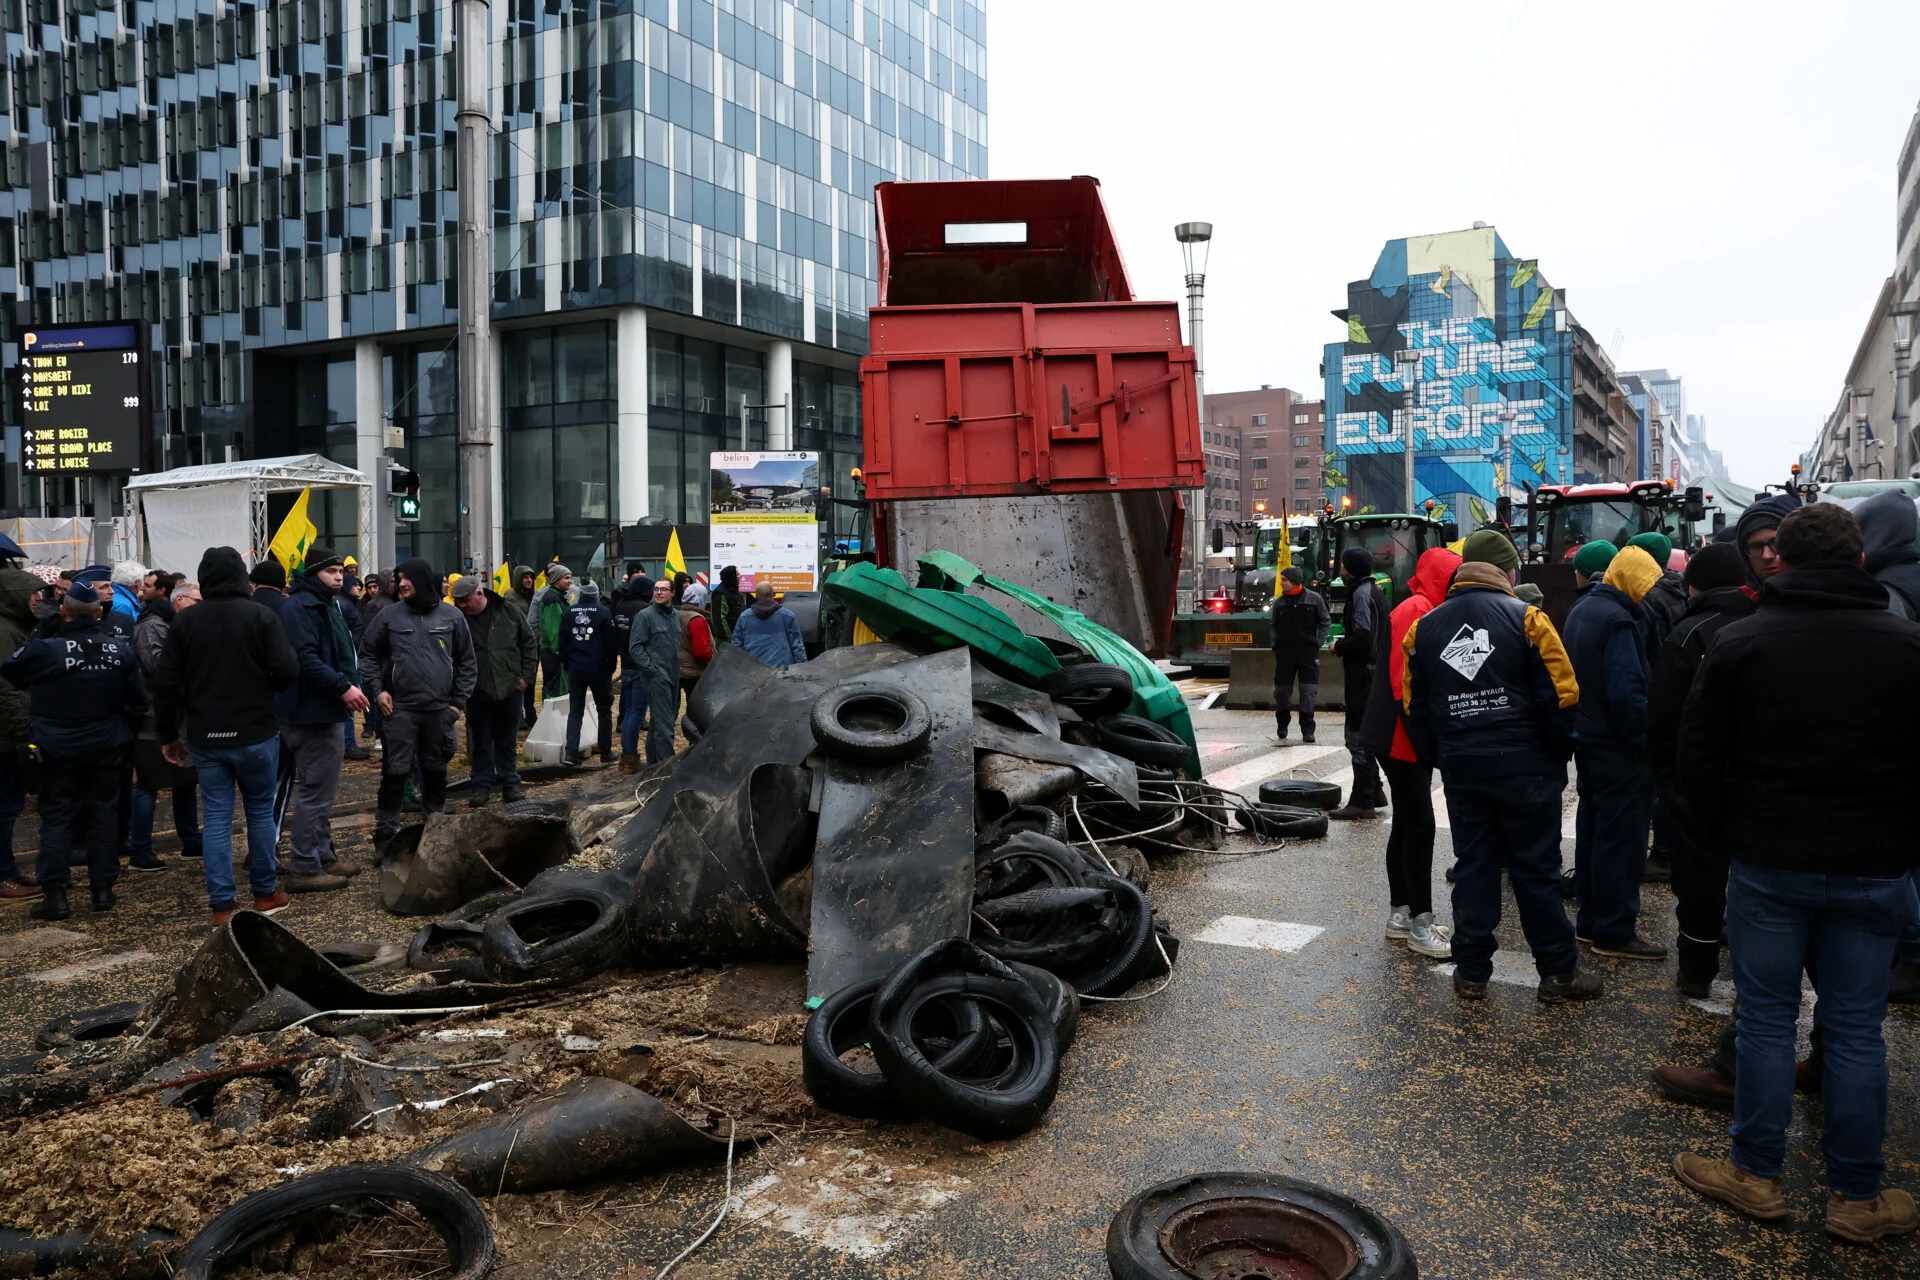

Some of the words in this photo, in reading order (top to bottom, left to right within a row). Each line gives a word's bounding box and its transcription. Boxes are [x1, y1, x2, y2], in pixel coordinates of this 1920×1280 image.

[1397, 316, 1477, 349] THE
[32, 357, 53, 367] THON
[56, 356, 67, 367] EU
[122, 352, 138, 364] 170
[1341, 337, 1538, 386] FUTURE
[33, 370, 72, 383] DANSAERT
[33, 386, 54, 397] GARE
[57, 385, 68, 396] DU
[72, 384, 91, 395] MIDI
[1419, 379, 1453, 406] IS
[34, 400, 49, 411] LOI
[124, 396, 139, 407] 999
[1335, 398, 1546, 446] EUROPE
[35, 430, 54, 441] ZONE
[59, 428, 88, 440] ROGIER
[36, 444, 55, 455] ZONE
[59, 443, 84, 454] GRAND
[88, 441, 112, 453] PLACE
[36, 459, 56, 470] ZONE
[60, 457, 89, 469] LOUISE
[1462, 655, 1475, 663] FJA
[1460, 691, 1479, 699] Roger
[1480, 687, 1505, 697] MYAUX
